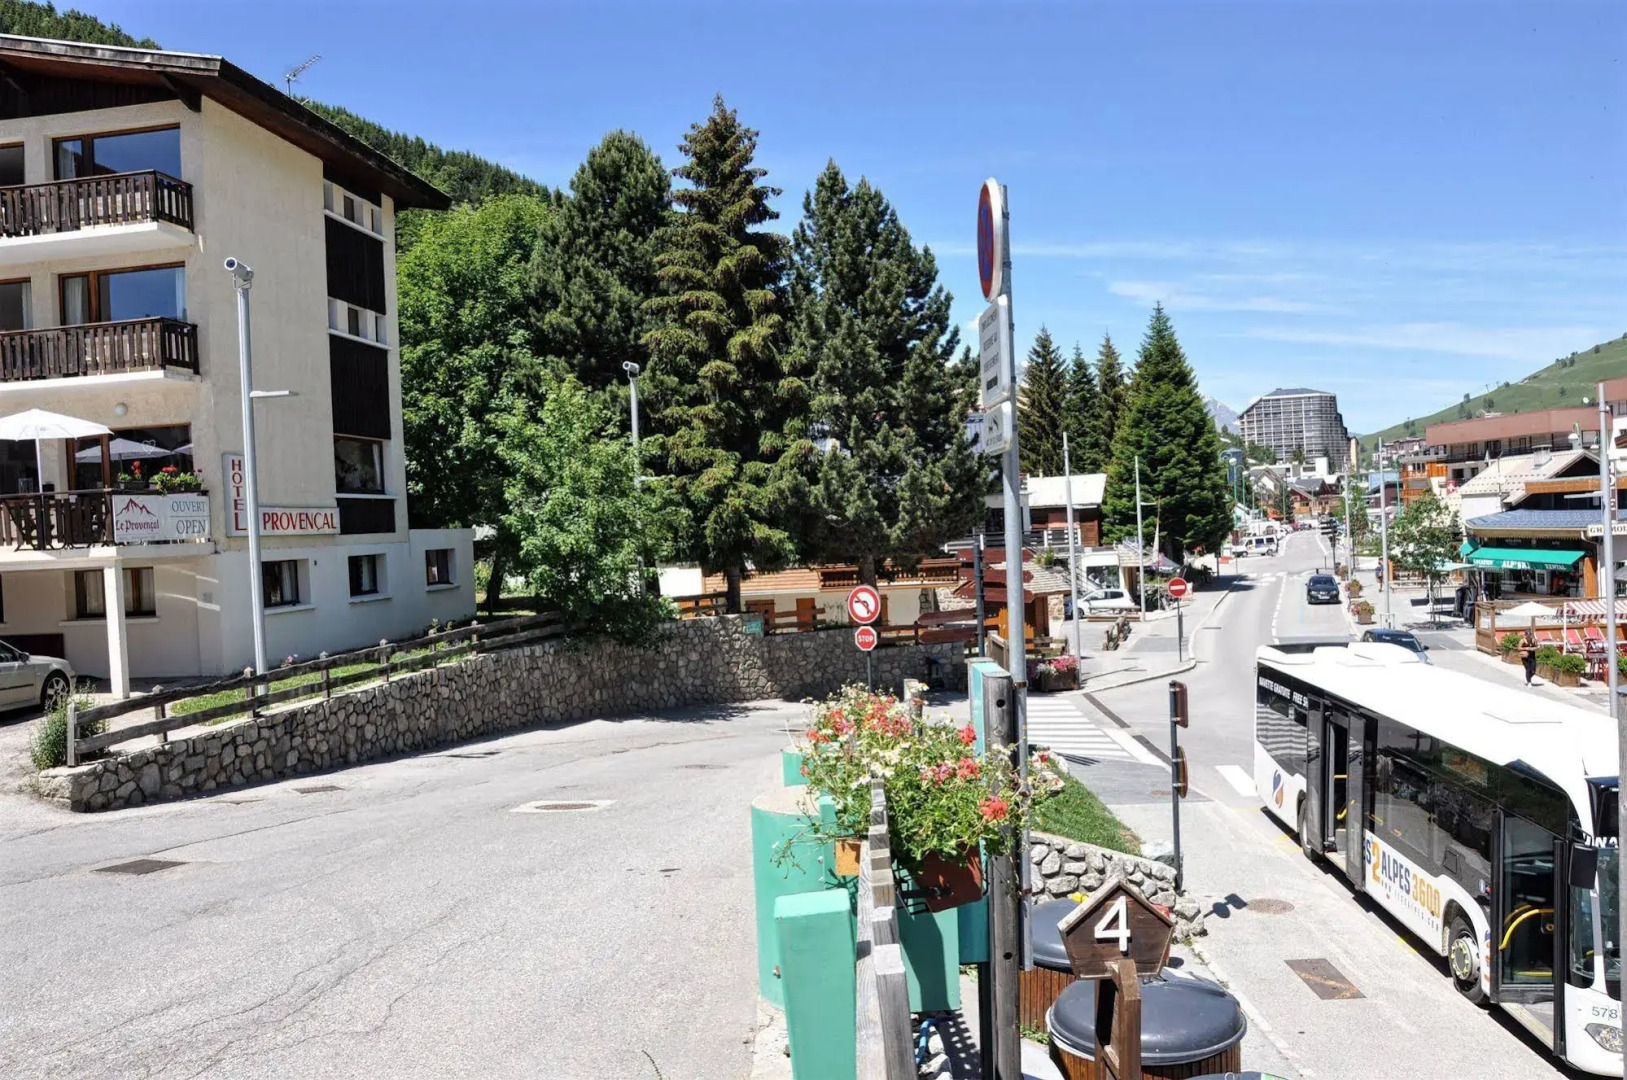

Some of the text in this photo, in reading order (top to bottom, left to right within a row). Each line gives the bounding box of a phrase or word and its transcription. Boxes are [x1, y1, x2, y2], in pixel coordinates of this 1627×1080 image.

[231, 459, 247, 531] HOTEL
[171, 500, 206, 513] OUVERT
[116, 518, 160, 533] Le Provençal
[176, 519, 206, 535] OPEN
[262, 511, 337, 532] PROVENÇAL
[858, 635, 874, 643] STOP
[1258, 676, 1274, 691] NAVETTE
[1273, 682, 1291, 700] GRATUITE
[1372, 841, 1381, 883] 2
[1381, 850, 1411, 896] ALPES
[1412, 872, 1441, 919] 3600
[1094, 895, 1131, 952] 4
[1591, 1005, 1618, 1019] 578
